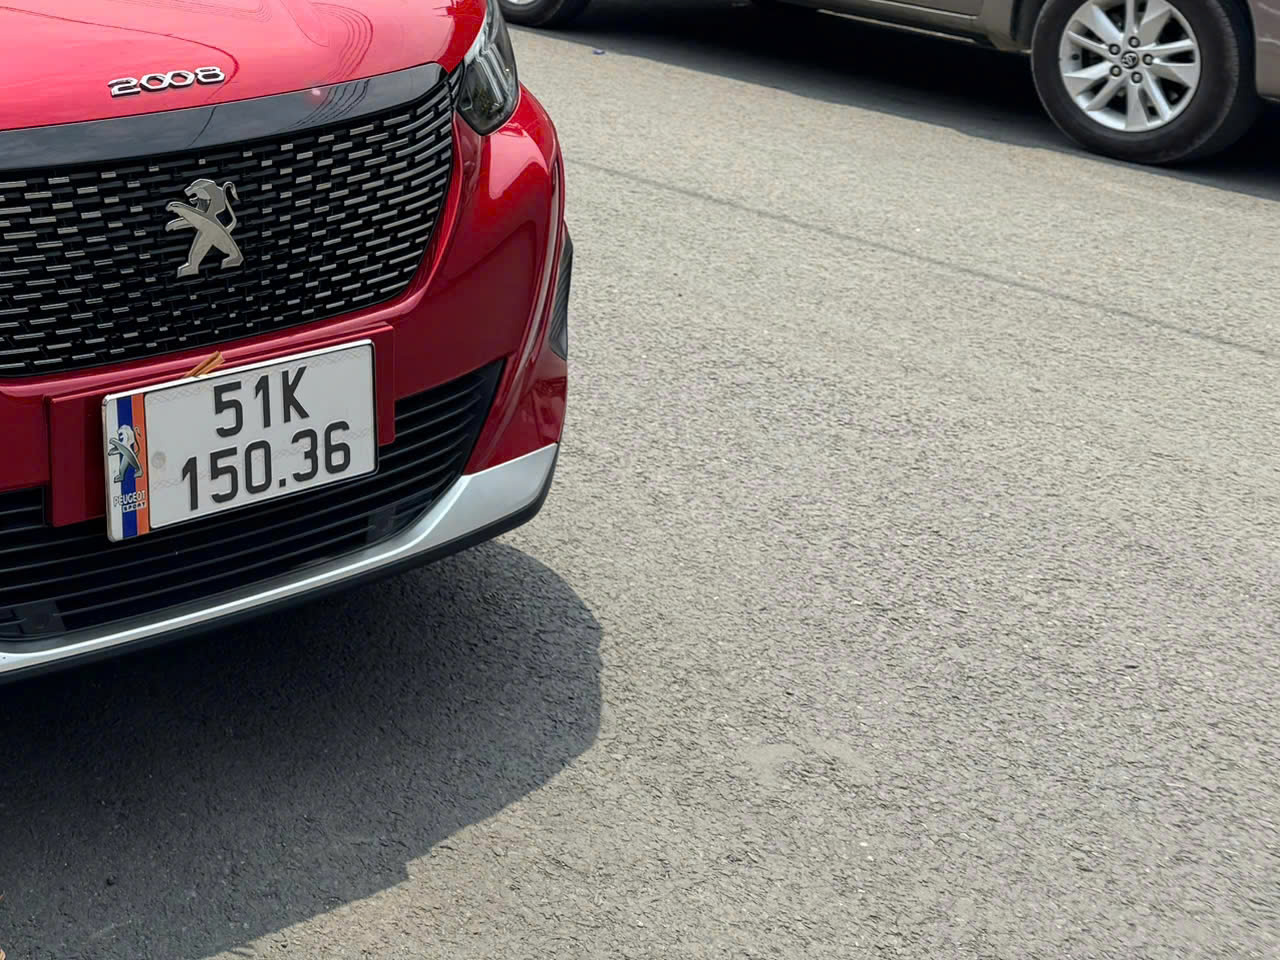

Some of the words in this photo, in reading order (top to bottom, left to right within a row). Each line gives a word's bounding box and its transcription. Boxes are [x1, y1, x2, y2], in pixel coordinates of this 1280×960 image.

[107, 66, 225, 97] 2008
[213, 366, 309, 438] 51K
[181, 420, 351, 511] 150.36
[113, 490, 146, 508] PEUGEOT
